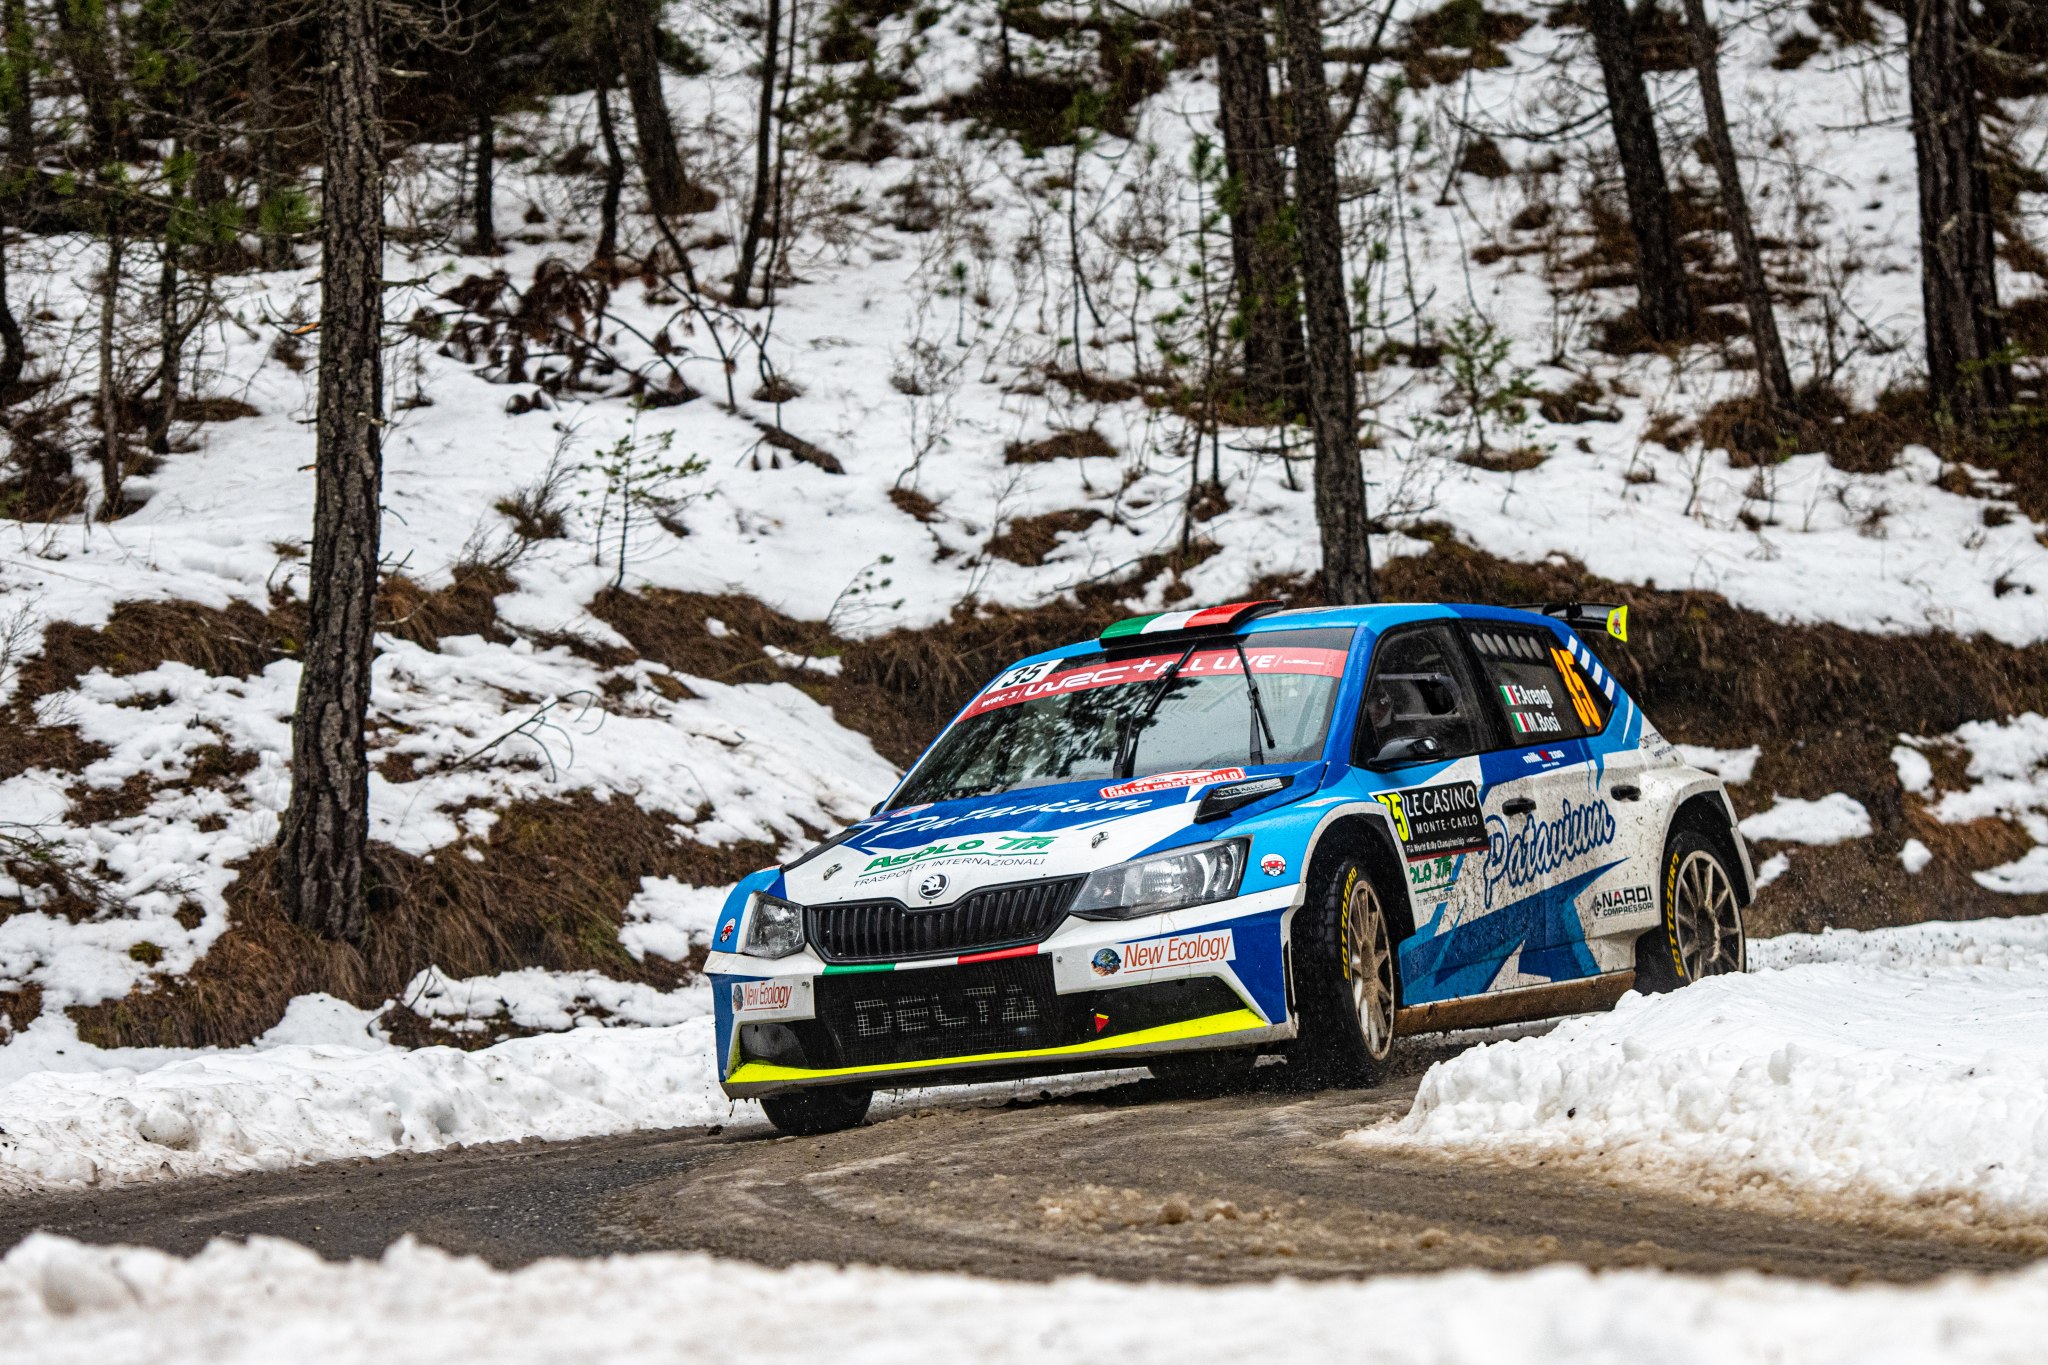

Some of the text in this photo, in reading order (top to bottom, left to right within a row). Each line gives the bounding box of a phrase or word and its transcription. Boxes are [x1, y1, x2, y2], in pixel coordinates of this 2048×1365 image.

[1001, 662, 1050, 688] 35
[981, 693, 1008, 707] WRC
[1008, 691, 1019, 699] 3
[1511, 684, 1554, 709] F.Arengi
[1550, 647, 1603, 733] 35
[1523, 711, 1562, 732] M.Bosi
[1522, 751, 1543, 764] milk
[1108, 785, 1151, 798] RALLYE
[1405, 785, 1476, 817] LE CASINO
[861, 799, 1153, 845] Patavium
[864, 839, 985, 871] ASOLO
[1414, 842, 1427, 853] World
[1426, 840, 1437, 851] Rally
[1437, 836, 1465, 849] Championship
[1483, 799, 1616, 909] Patavium
[853, 856, 1047, 888] TRASPORTI INTERNAZIONALI
[1602, 886, 1653, 909] NARDI
[1603, 902, 1655, 917] COMPRESSORI
[1341, 866, 1358, 981] SOTTOZERO
[1124, 935, 1231, 968] New Ecology
[744, 982, 793, 1009] New Ecology
[854, 985, 1040, 1037] DELTA
